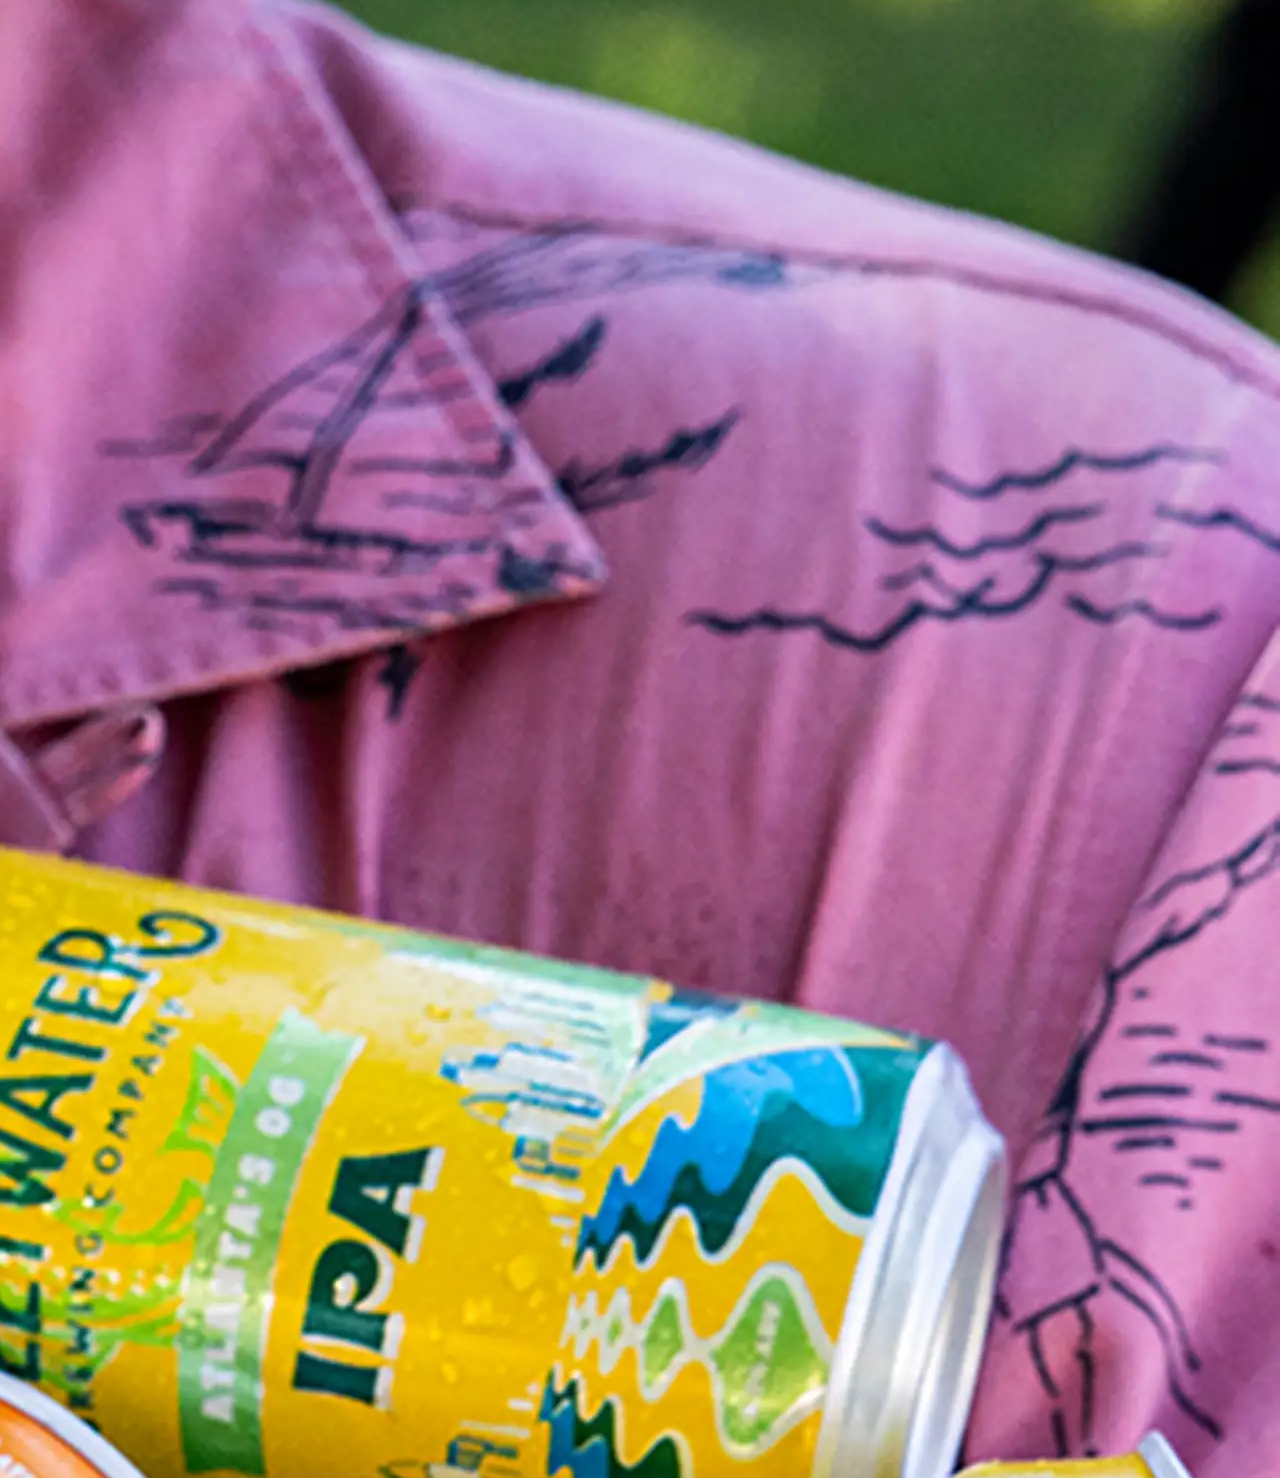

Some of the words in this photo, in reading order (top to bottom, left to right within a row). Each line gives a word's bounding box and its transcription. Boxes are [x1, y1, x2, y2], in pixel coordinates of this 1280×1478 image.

[83, 997, 192, 1211] COMPANY
[198, 1148, 280, 1425] ATLANTA'S
[254, 1070, 308, 1138] OG
[289, 1144, 448, 1413] IPA
